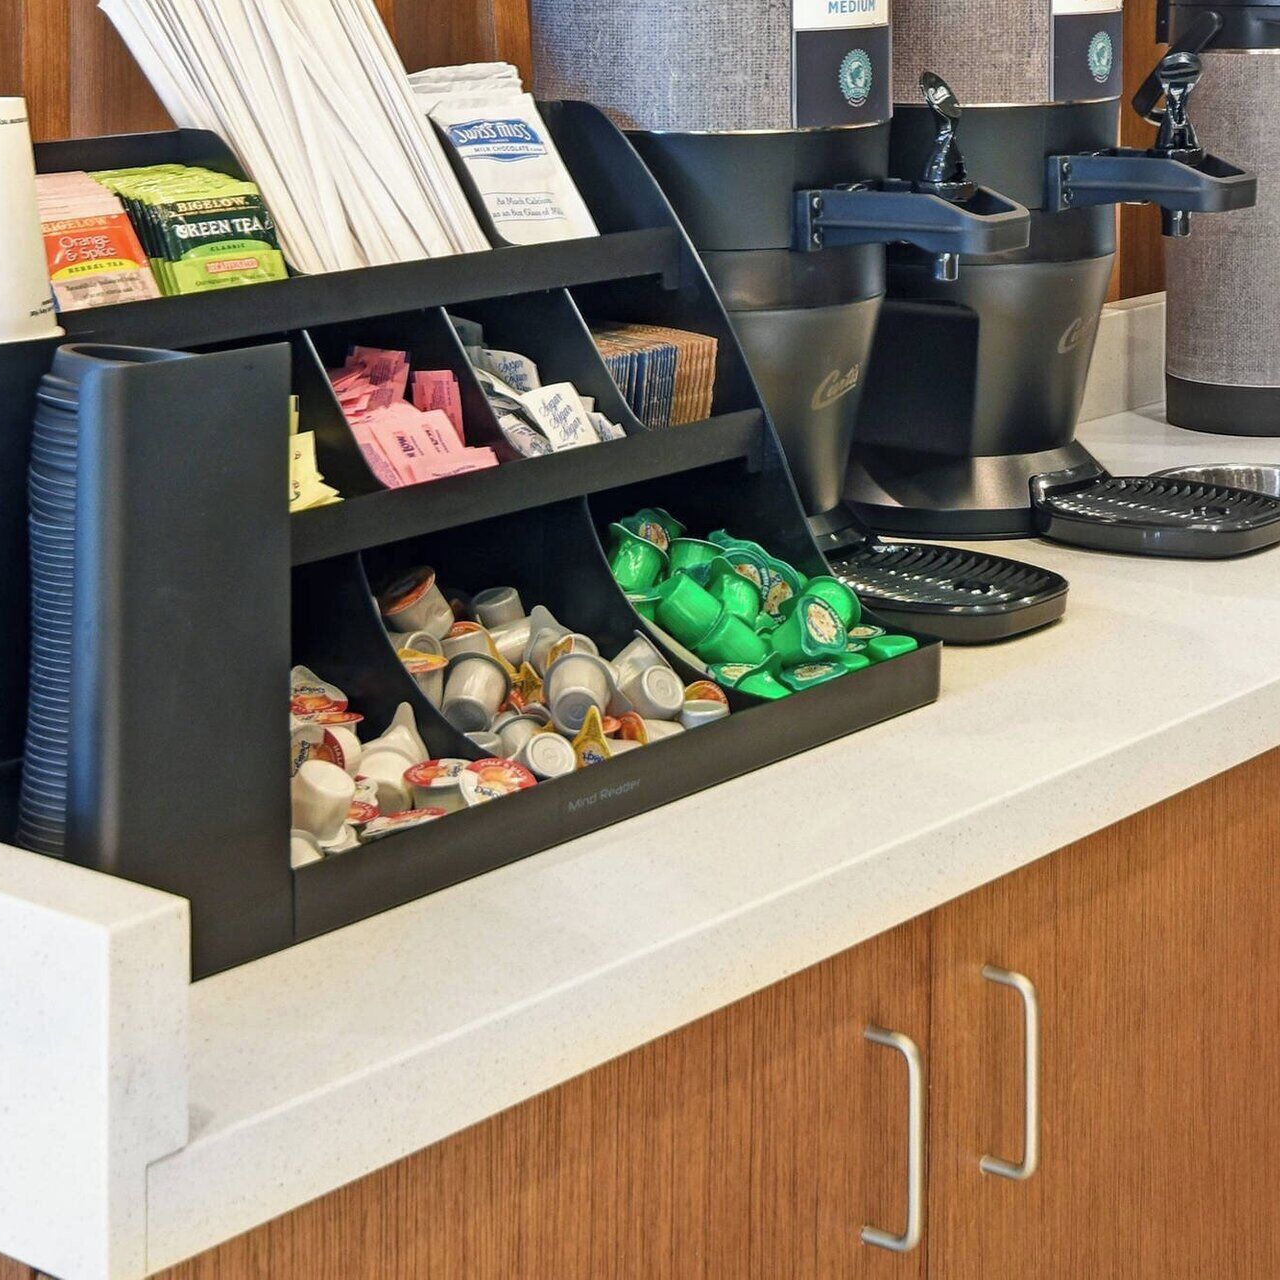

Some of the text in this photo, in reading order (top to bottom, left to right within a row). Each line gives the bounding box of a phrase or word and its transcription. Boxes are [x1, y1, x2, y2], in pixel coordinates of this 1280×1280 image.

[828, 0, 875, 14] MEDIUM
[494, 145, 530, 153] CHOCOLATE
[176, 197, 246, 213] BIGELOW
[497, 196, 553, 205] As Much Calcium
[523, 207, 541, 216] Glass
[173, 216, 263, 239] GREEN TEA
[60, 236, 110, 249] Orange
[210, 243, 246, 252] CLASSIC
[65, 247, 117, 261] & Spice
[67, 261, 124, 273] HERBAL TEA
[539, 393, 563, 417] Sugar
[550, 404, 573, 429] Sugar
[559, 417, 581, 441] Sugar
[568, 779, 641, 811] Mind Reader
